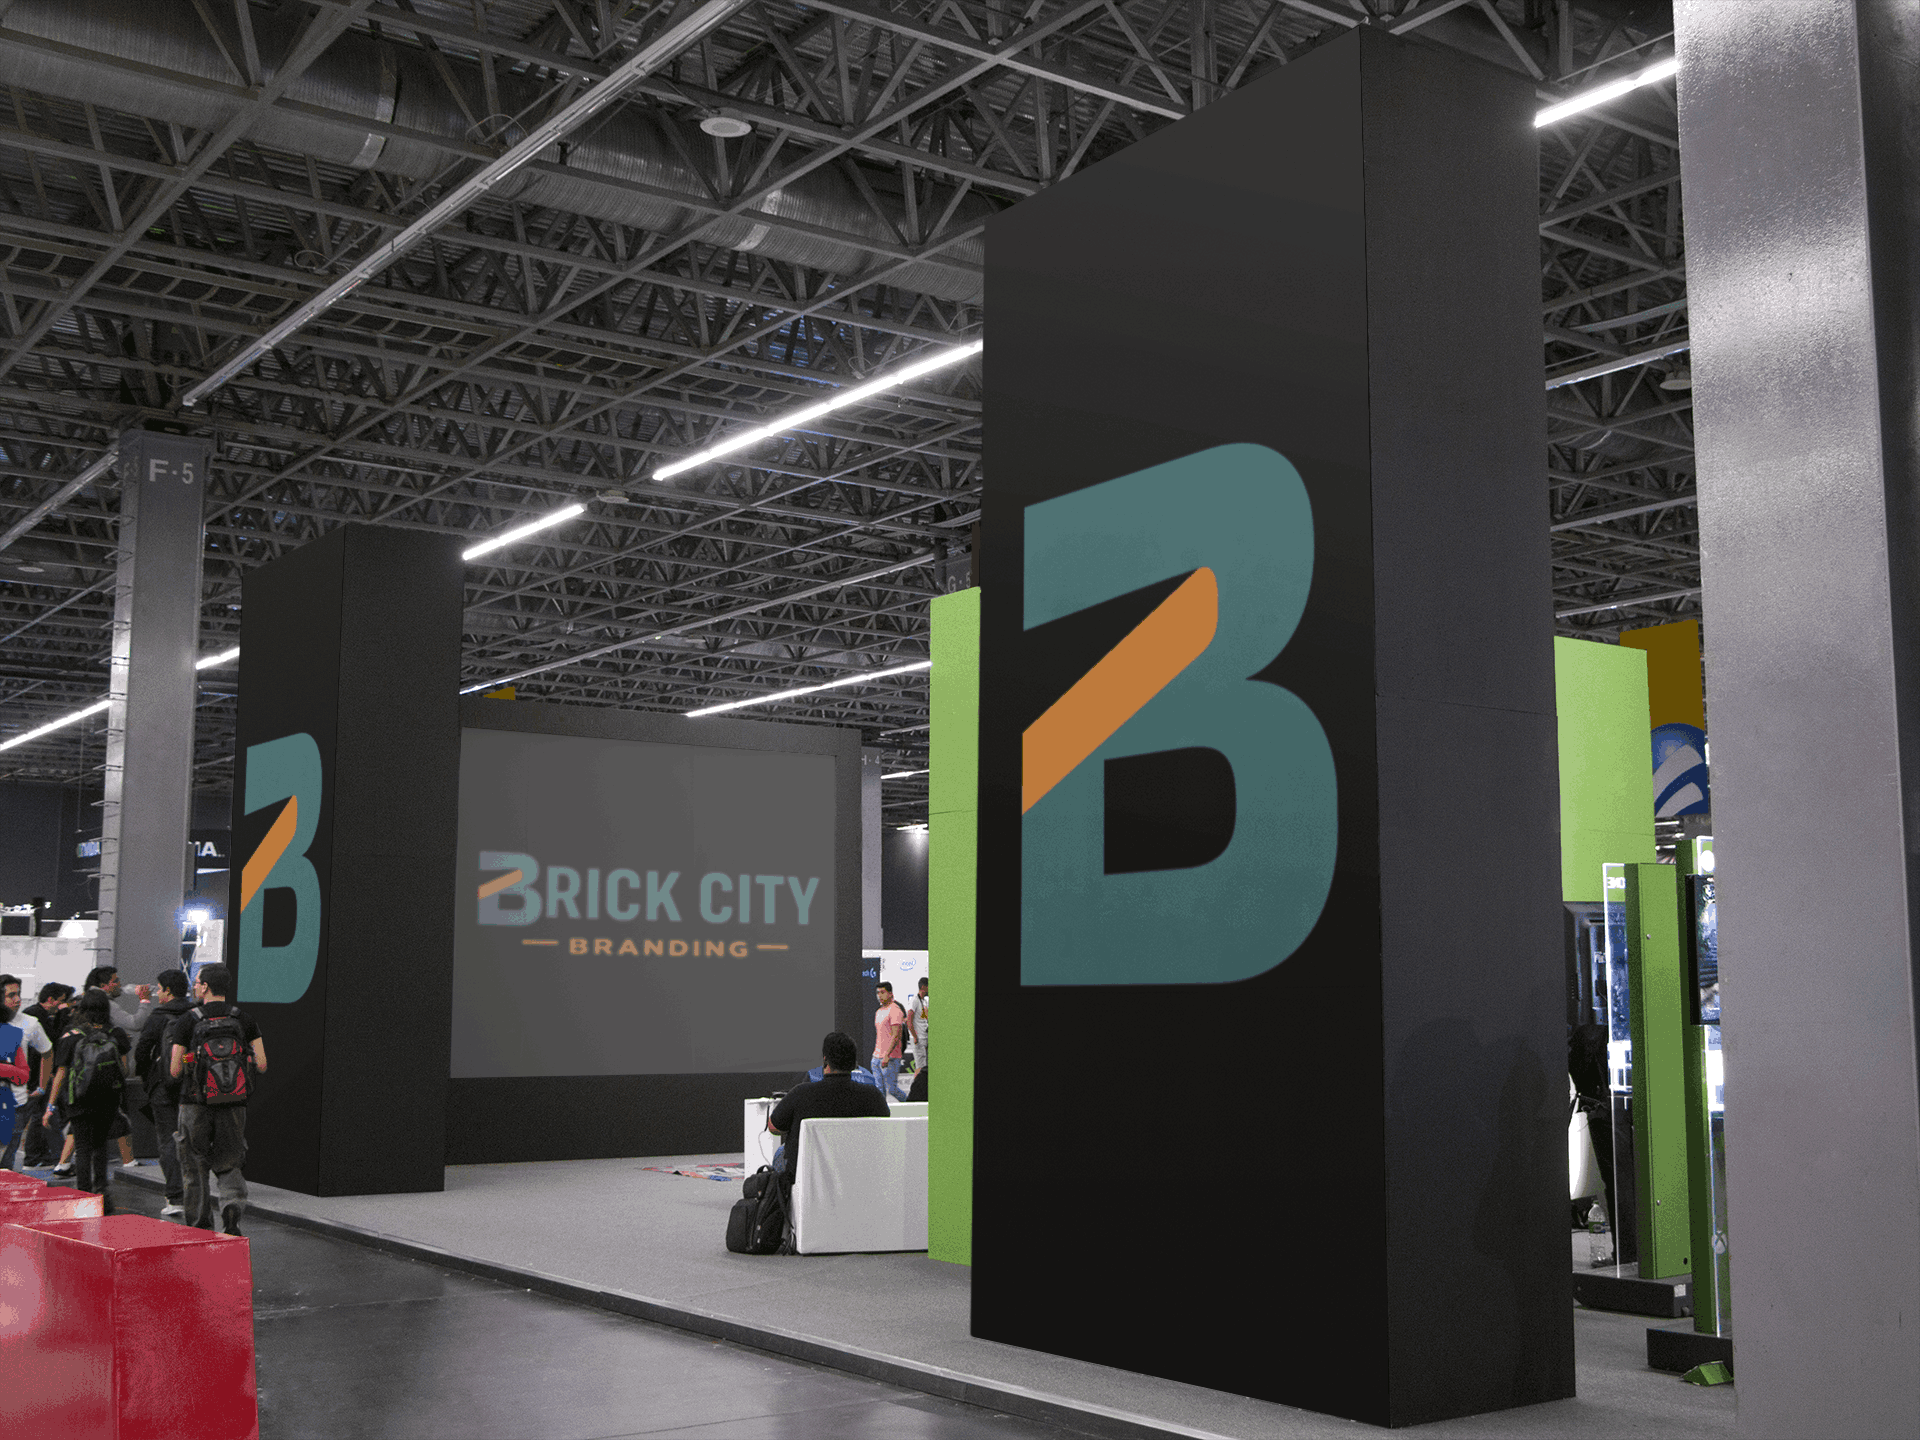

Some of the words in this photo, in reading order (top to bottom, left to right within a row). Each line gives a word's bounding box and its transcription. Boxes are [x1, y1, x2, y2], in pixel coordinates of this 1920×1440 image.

[1020, 442, 1339, 986] B
[237, 732, 323, 1003] B
[477, 850, 682, 927] BRICK
[699, 872, 820, 926] CITY
[569, 938, 748, 958] BRANDING
